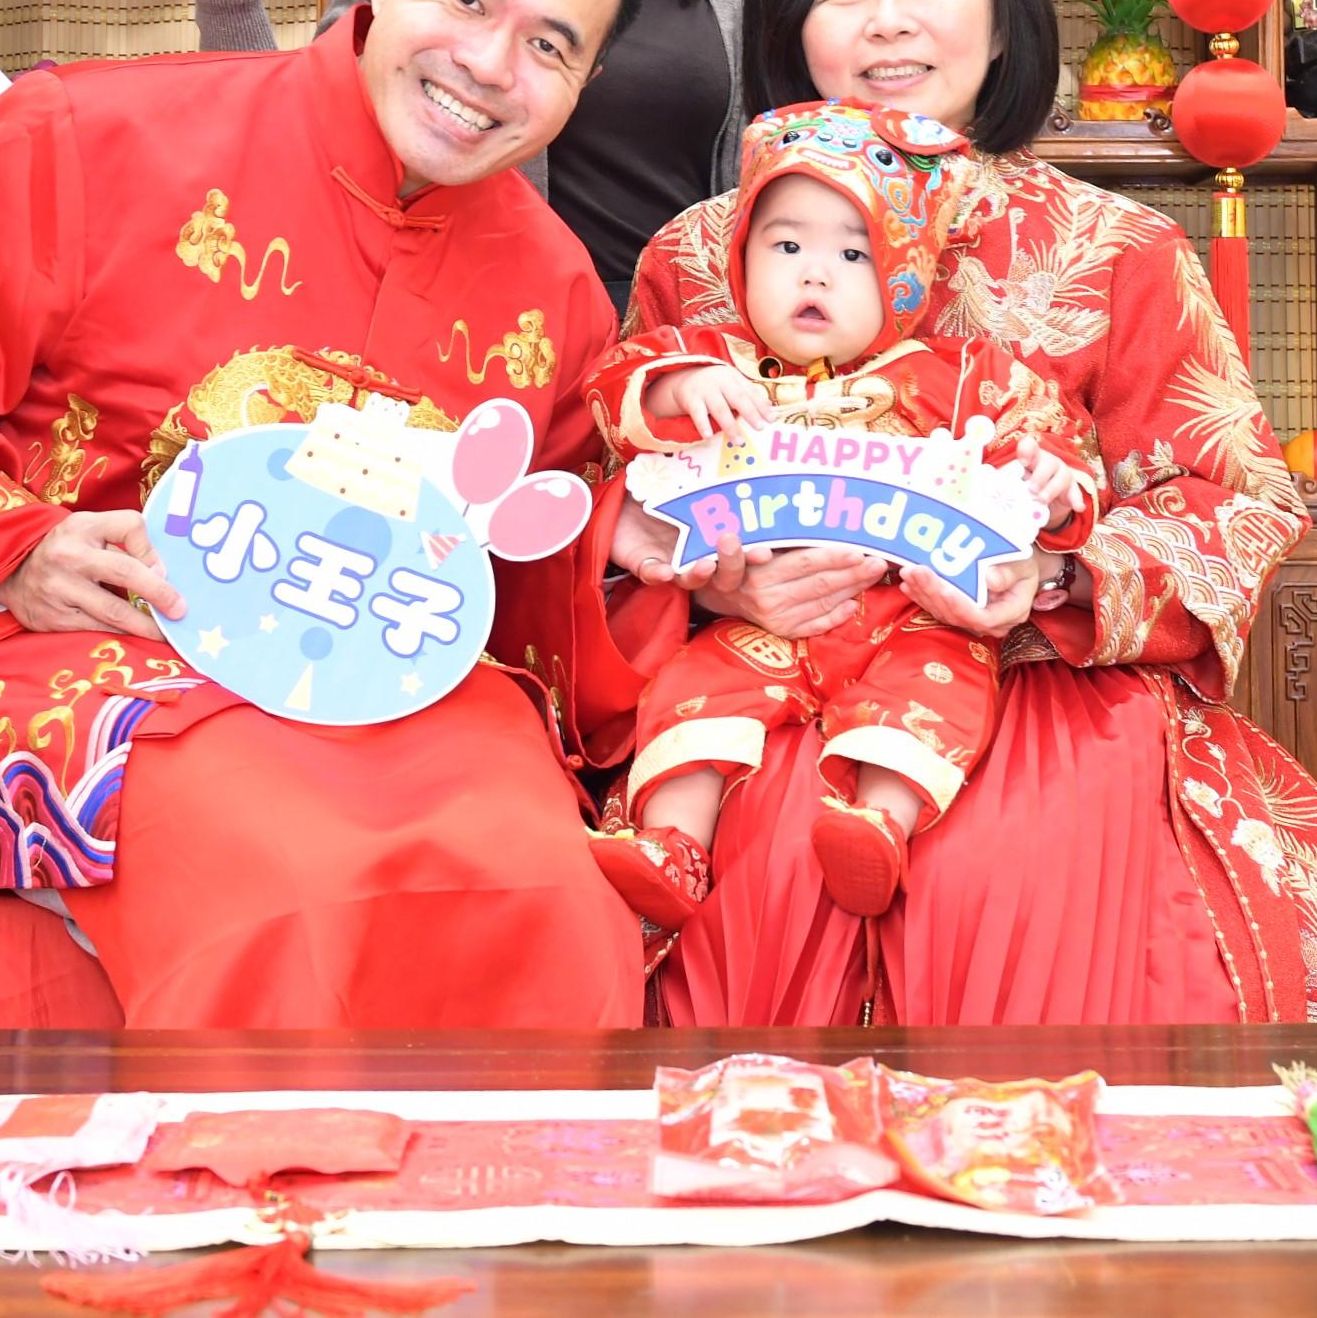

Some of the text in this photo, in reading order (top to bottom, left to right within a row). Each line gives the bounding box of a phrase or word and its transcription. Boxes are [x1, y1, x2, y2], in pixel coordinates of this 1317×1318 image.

[770, 430, 924, 475] HAPPY
[690, 478, 986, 577] Birthday
[190, 498, 466, 659] 小王子
